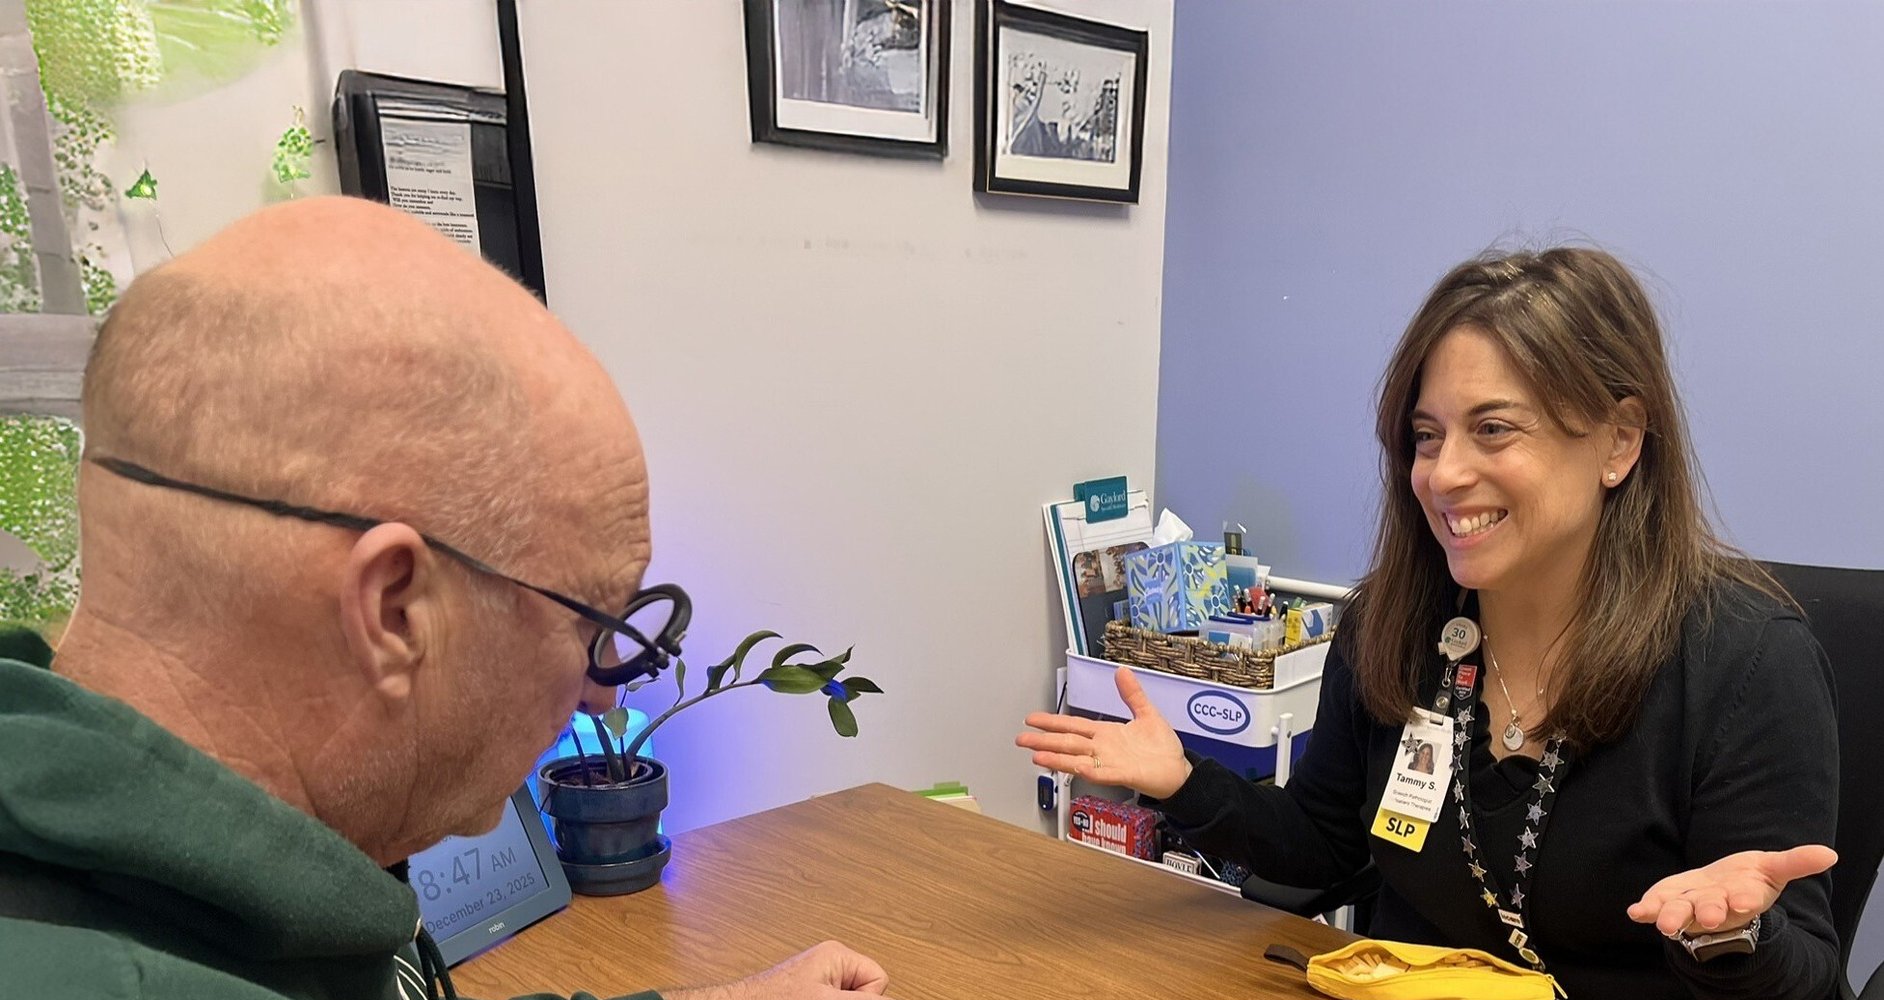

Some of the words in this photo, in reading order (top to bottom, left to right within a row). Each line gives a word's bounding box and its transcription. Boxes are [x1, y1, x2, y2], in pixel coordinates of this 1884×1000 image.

[1451, 627, 1466, 640] 30
[1194, 702, 1242, 722] CCC-SLP
[1396, 772, 1427, 790] Tammy
[1428, 781, 1438, 791] S.
[1095, 818, 1127, 843] should
[1386, 816, 1416, 838] SLP
[418, 847, 481, 902] 8:47
[491, 846, 517, 873] AM
[425, 898, 484, 934] December
[486, 887, 507, 905] 23,
[507, 872, 535, 896] 2025
[488, 921, 505, 934] robin
